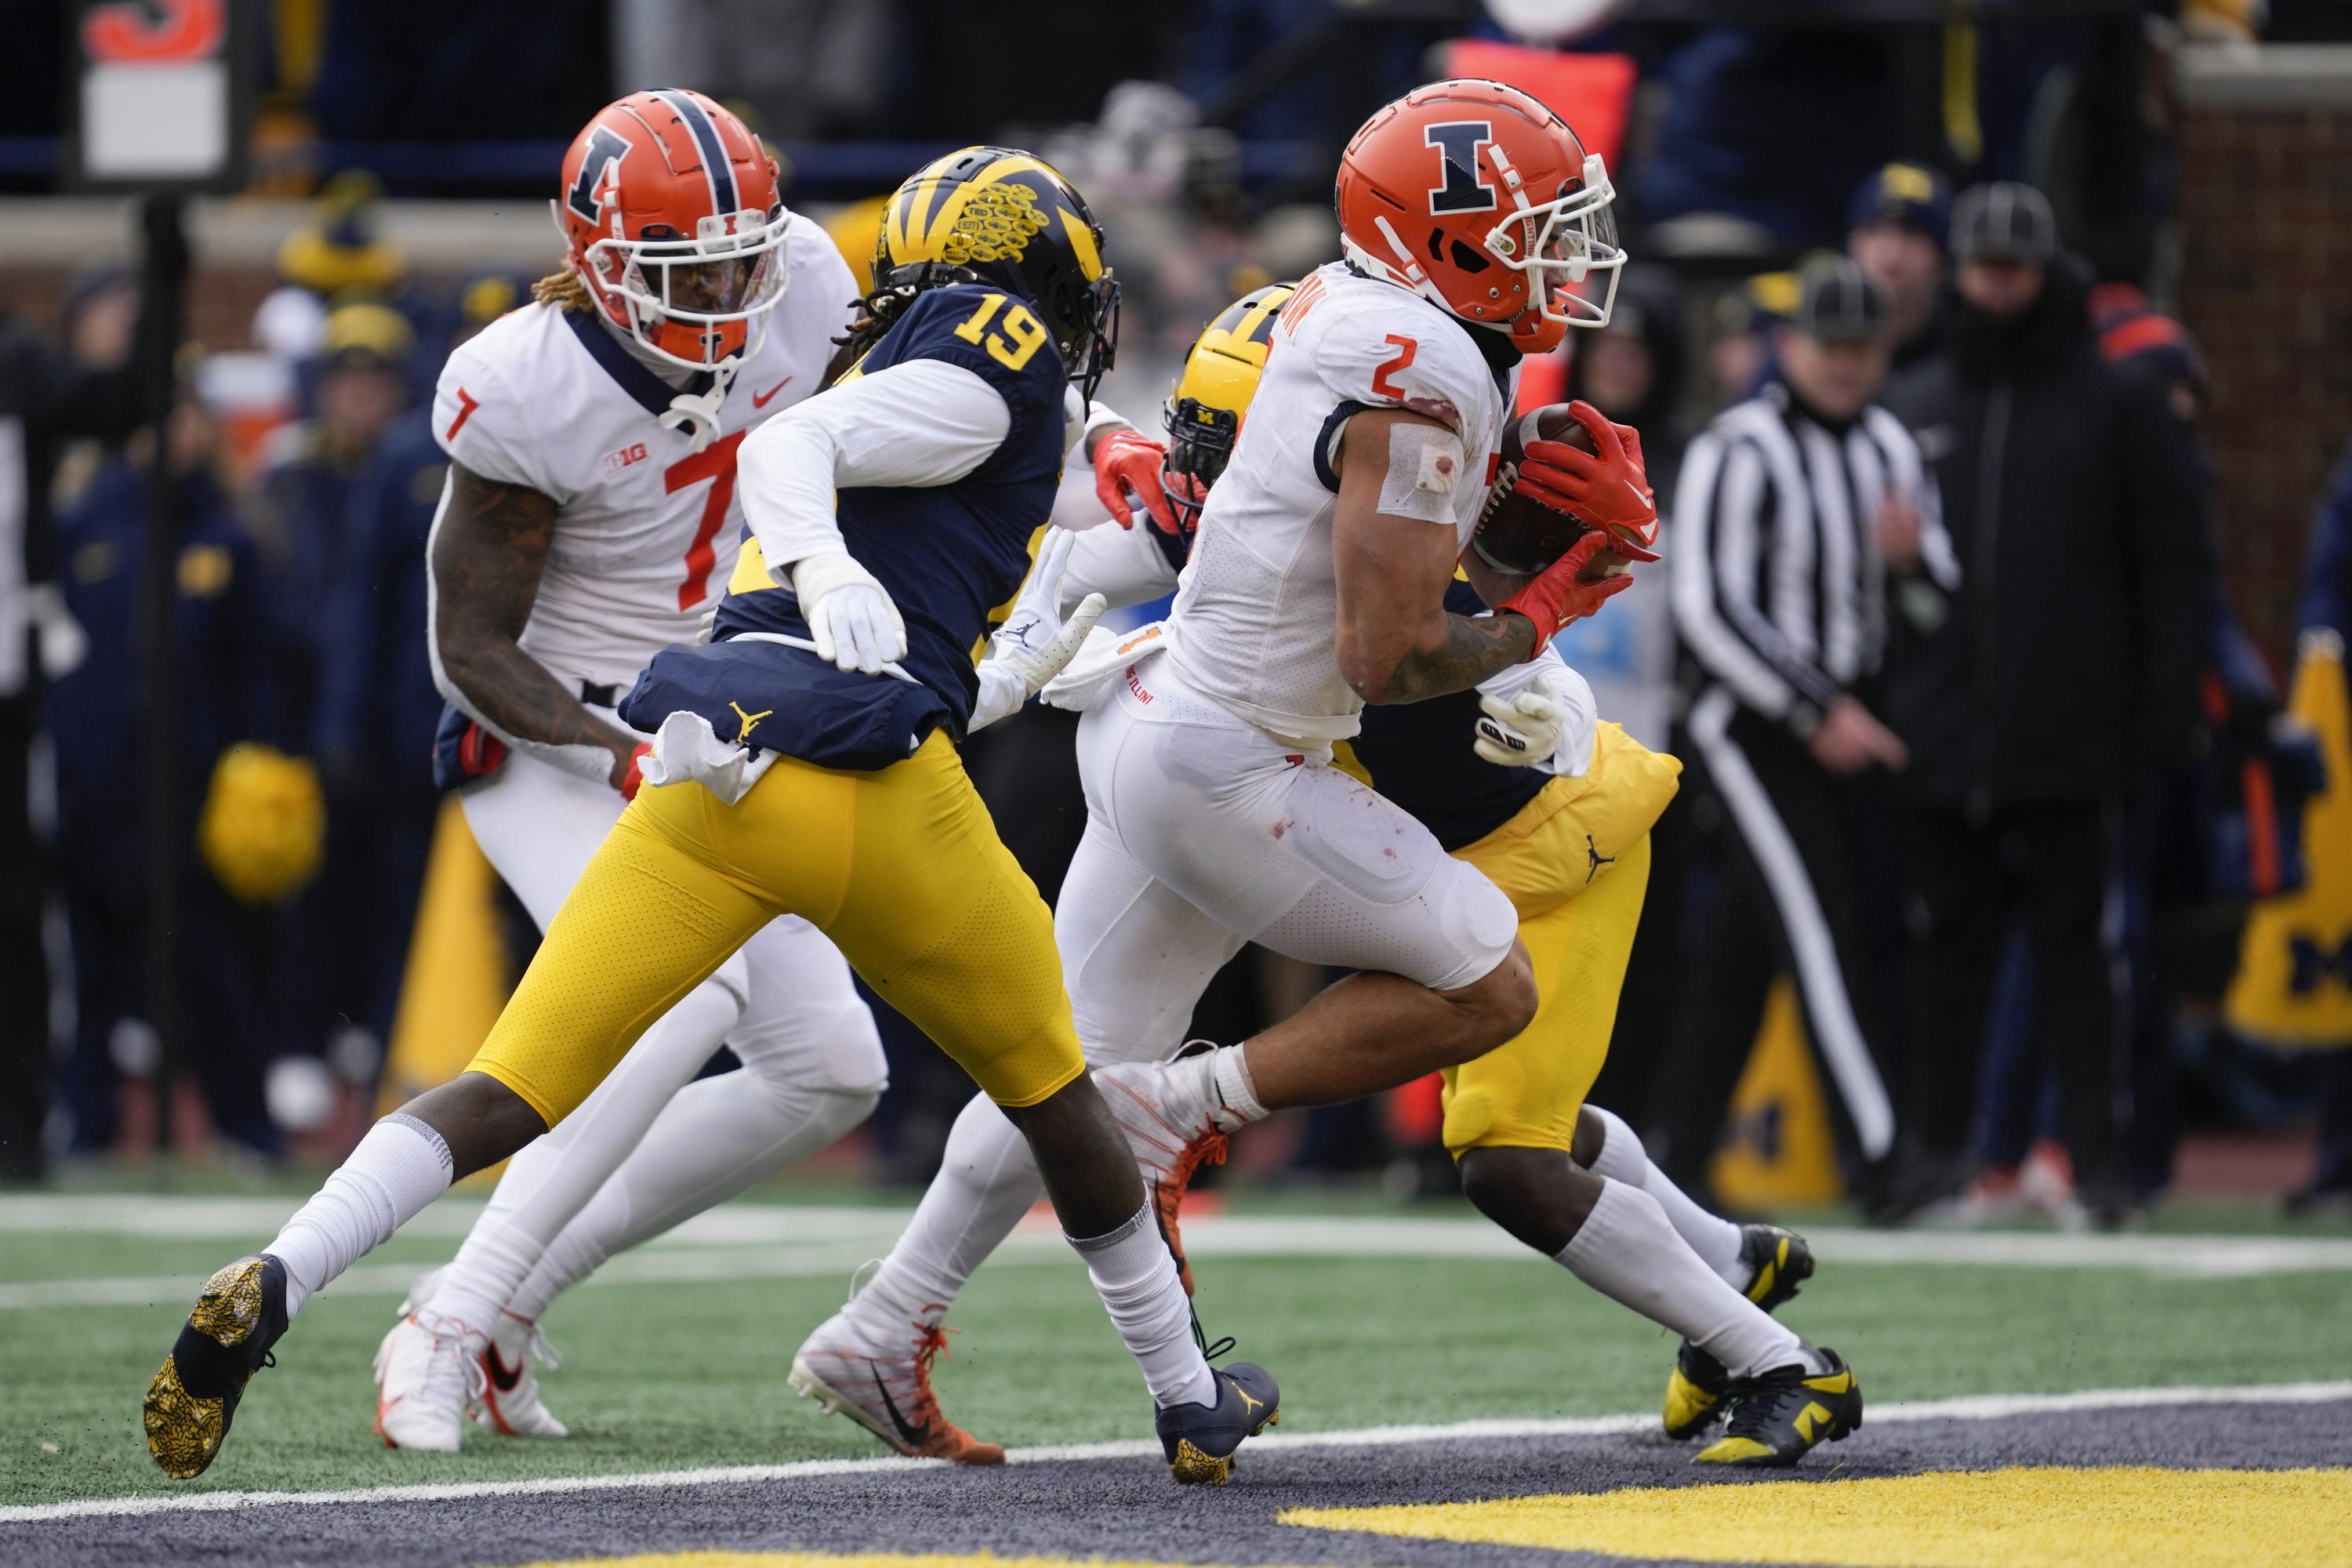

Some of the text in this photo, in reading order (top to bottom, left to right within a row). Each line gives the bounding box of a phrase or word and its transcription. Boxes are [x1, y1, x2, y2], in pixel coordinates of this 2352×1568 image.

[1424, 121, 1497, 216] I
[968, 208, 988, 216] TED
[953, 293, 1047, 371] 19
[1371, 333, 1417, 401] 2
[445, 385, 479, 443] 7
[1197, 409, 1214, 425] M
[664, 429, 746, 612] 7
[1129, 677, 1154, 704] ILLINI
